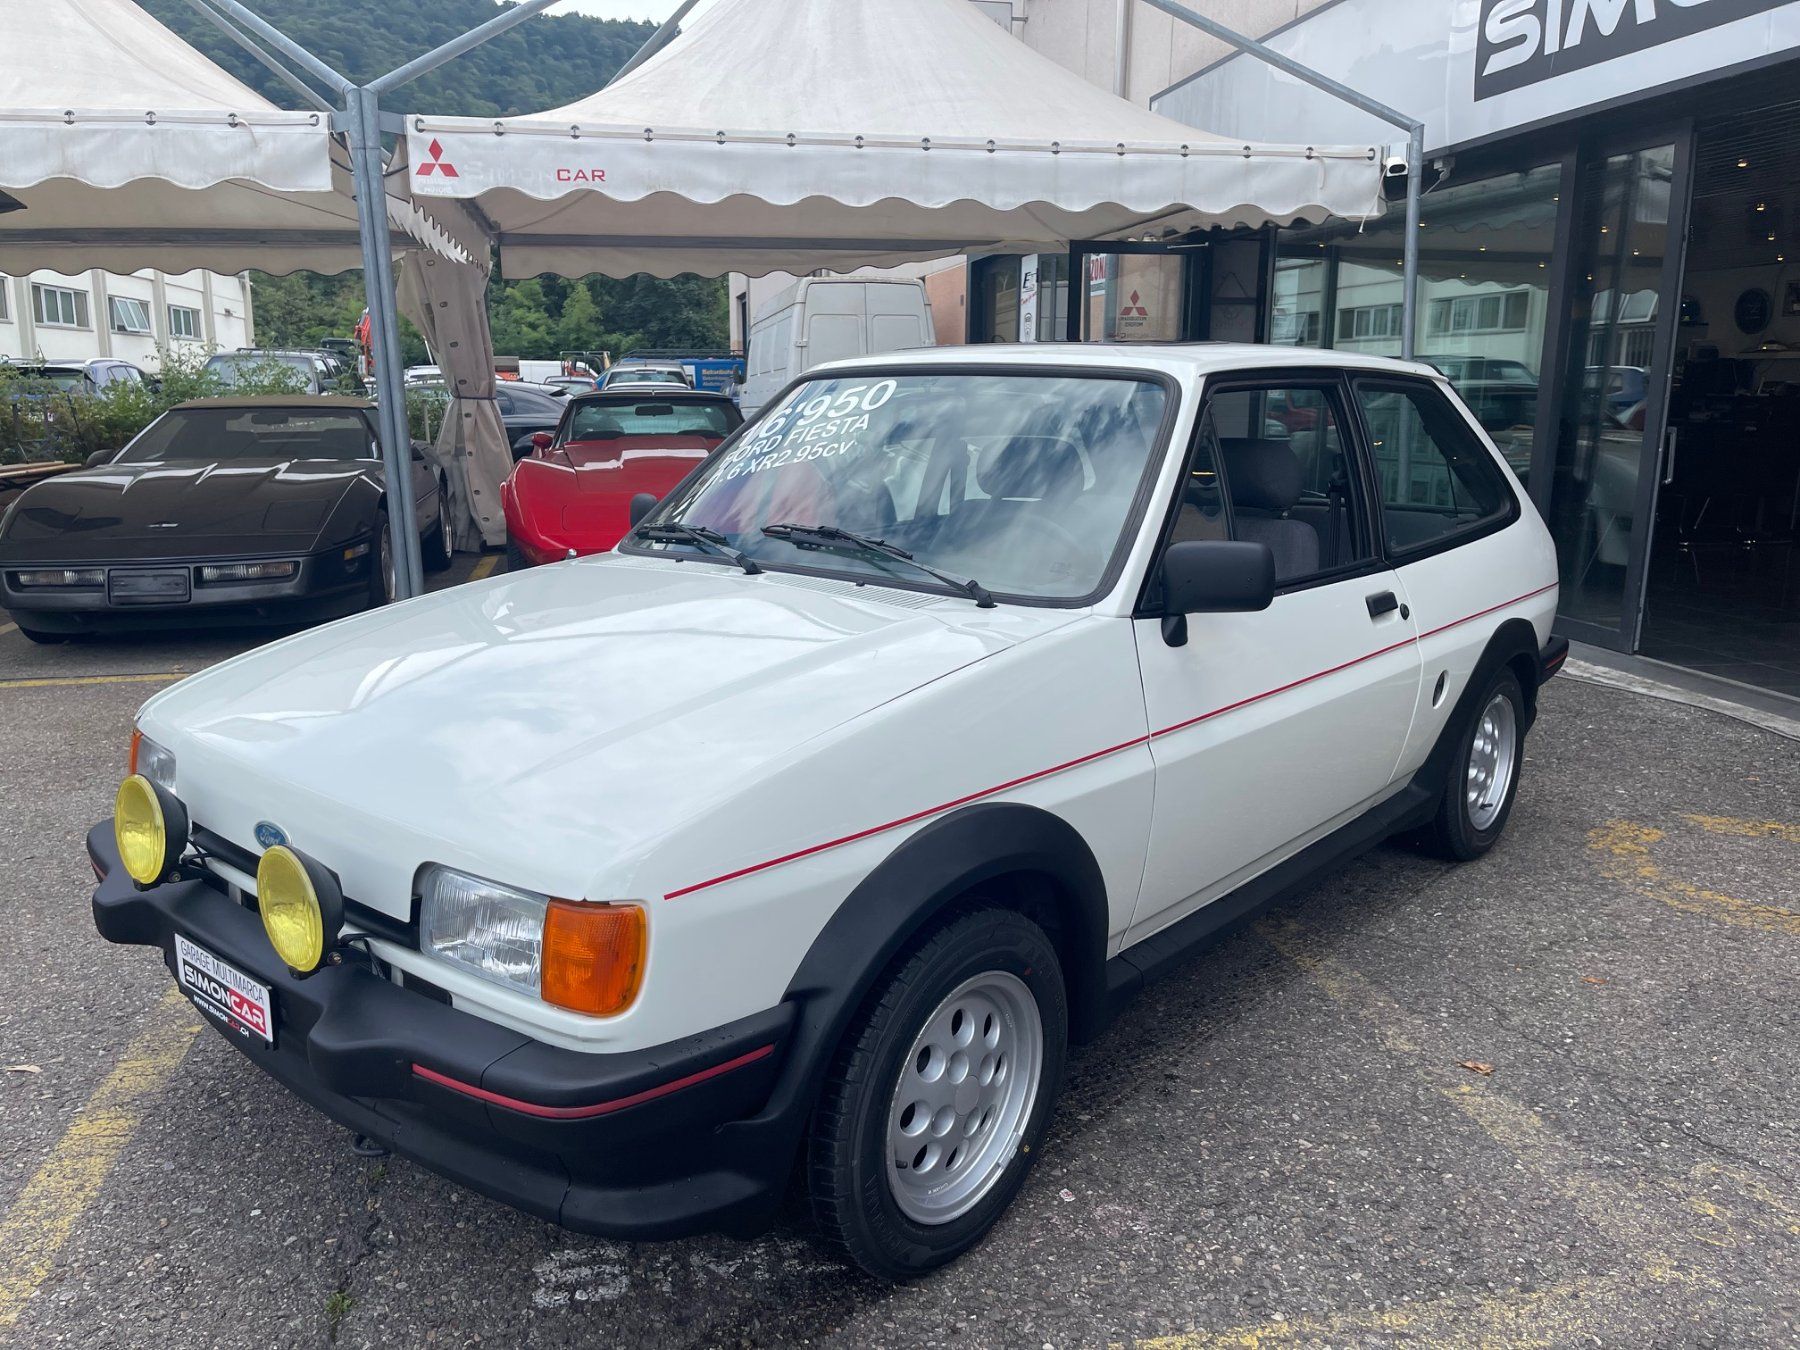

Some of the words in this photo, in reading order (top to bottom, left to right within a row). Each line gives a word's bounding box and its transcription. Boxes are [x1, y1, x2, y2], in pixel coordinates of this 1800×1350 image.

[556, 168, 607, 183] CAR
[719, 434, 783, 470] FORD
[784, 413, 870, 447] FIESTA
[741, 449, 793, 476] XR2
[180, 940, 211, 972] GARAGE
[212, 959, 265, 1005] MULTIMARCA
